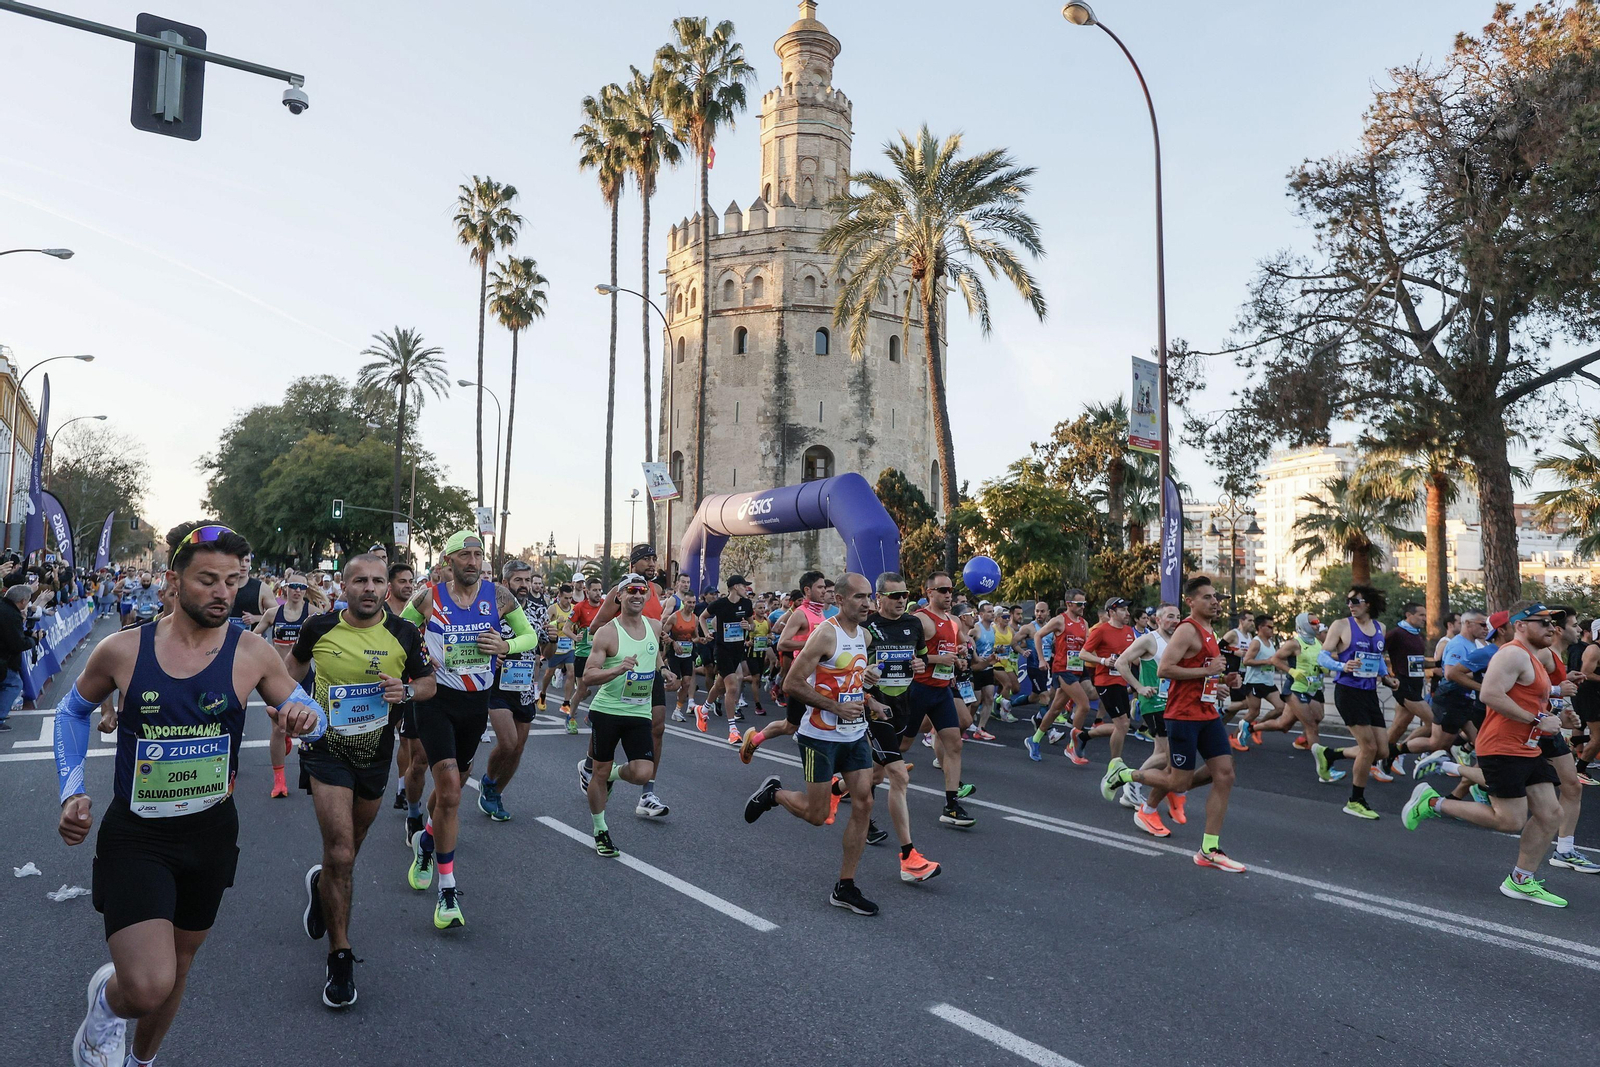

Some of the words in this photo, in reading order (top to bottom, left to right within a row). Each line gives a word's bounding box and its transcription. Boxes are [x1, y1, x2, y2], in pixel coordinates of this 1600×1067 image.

[445, 622, 491, 632] BERANGO
[351, 704, 370, 713] 4201
[348, 714, 375, 723] THARSIS
[169, 743, 219, 757] ZURICH
[168, 770, 197, 783] 2064
[138, 782, 224, 799] SALVADORYMANU
